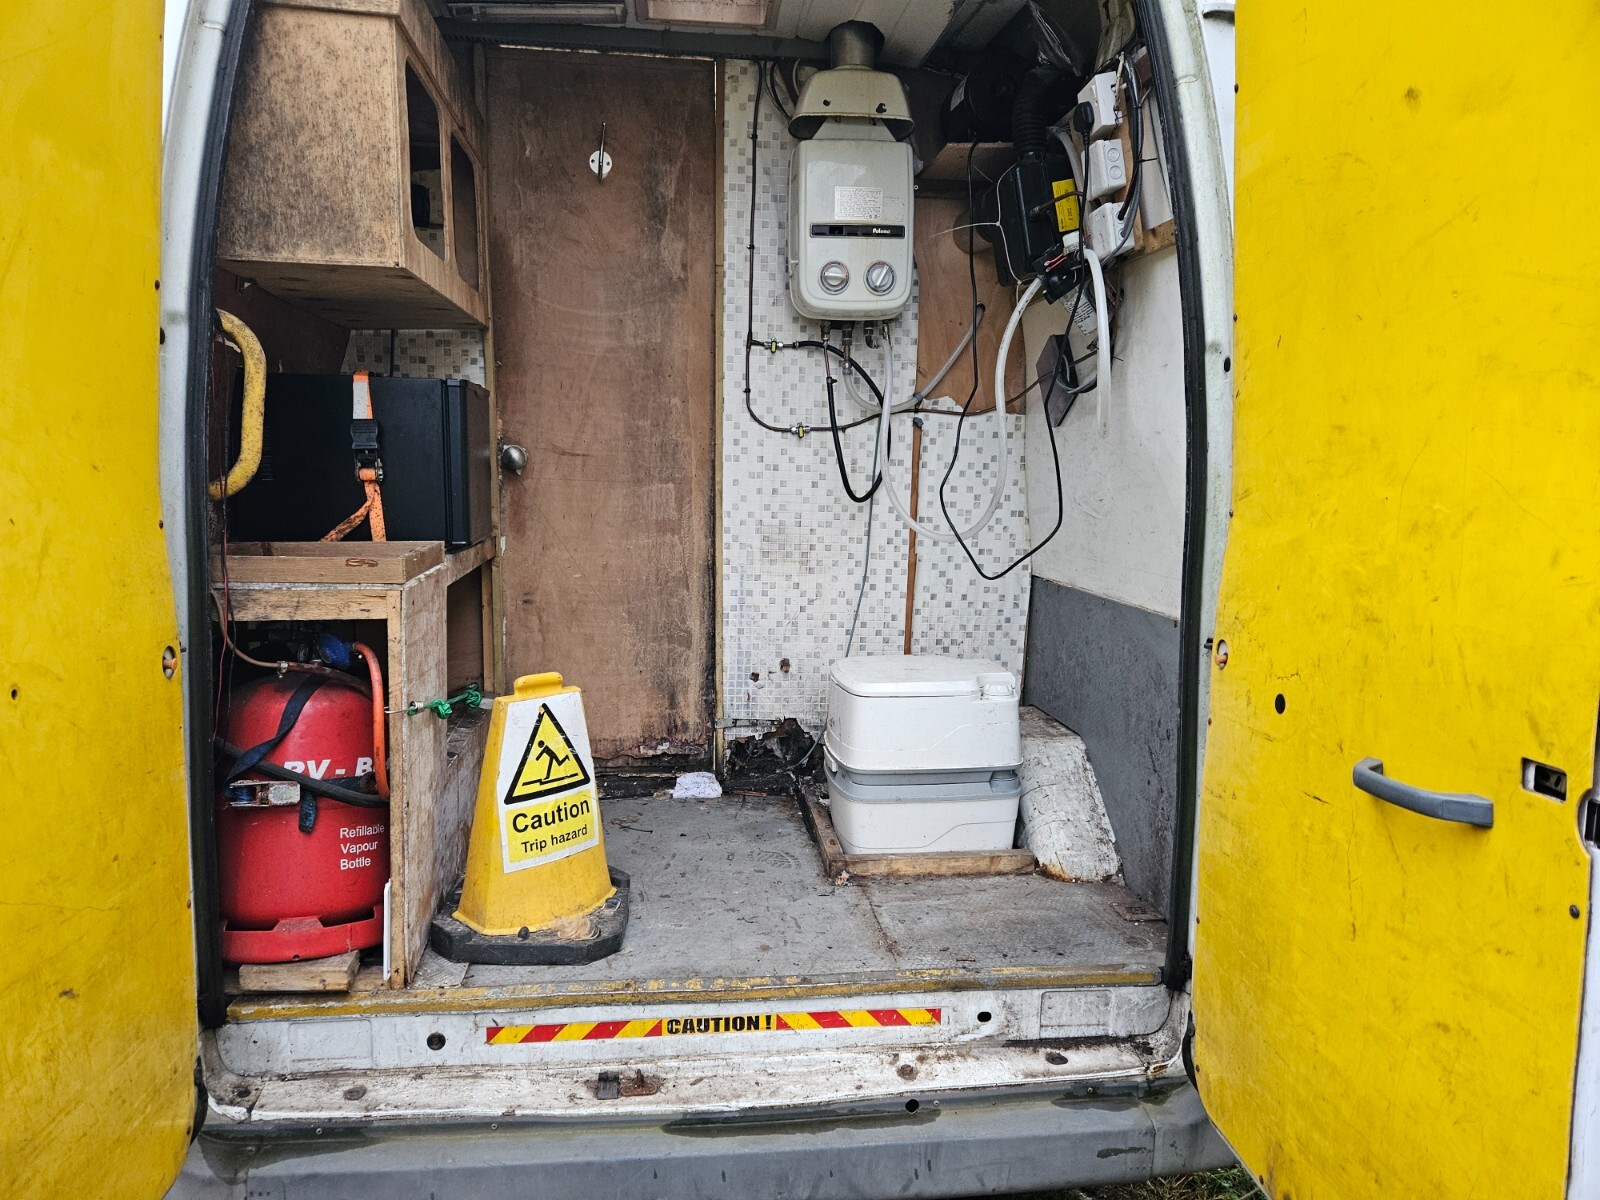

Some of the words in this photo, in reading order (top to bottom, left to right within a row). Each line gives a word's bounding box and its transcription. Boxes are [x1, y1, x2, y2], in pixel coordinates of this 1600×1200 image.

[512, 799, 591, 834] Caution
[339, 824, 385, 839] Refillable
[521, 838, 547, 854] Trip
[550, 824, 588, 847] hazard
[340, 841, 379, 855] Vapour
[340, 857, 371, 871] Bottle
